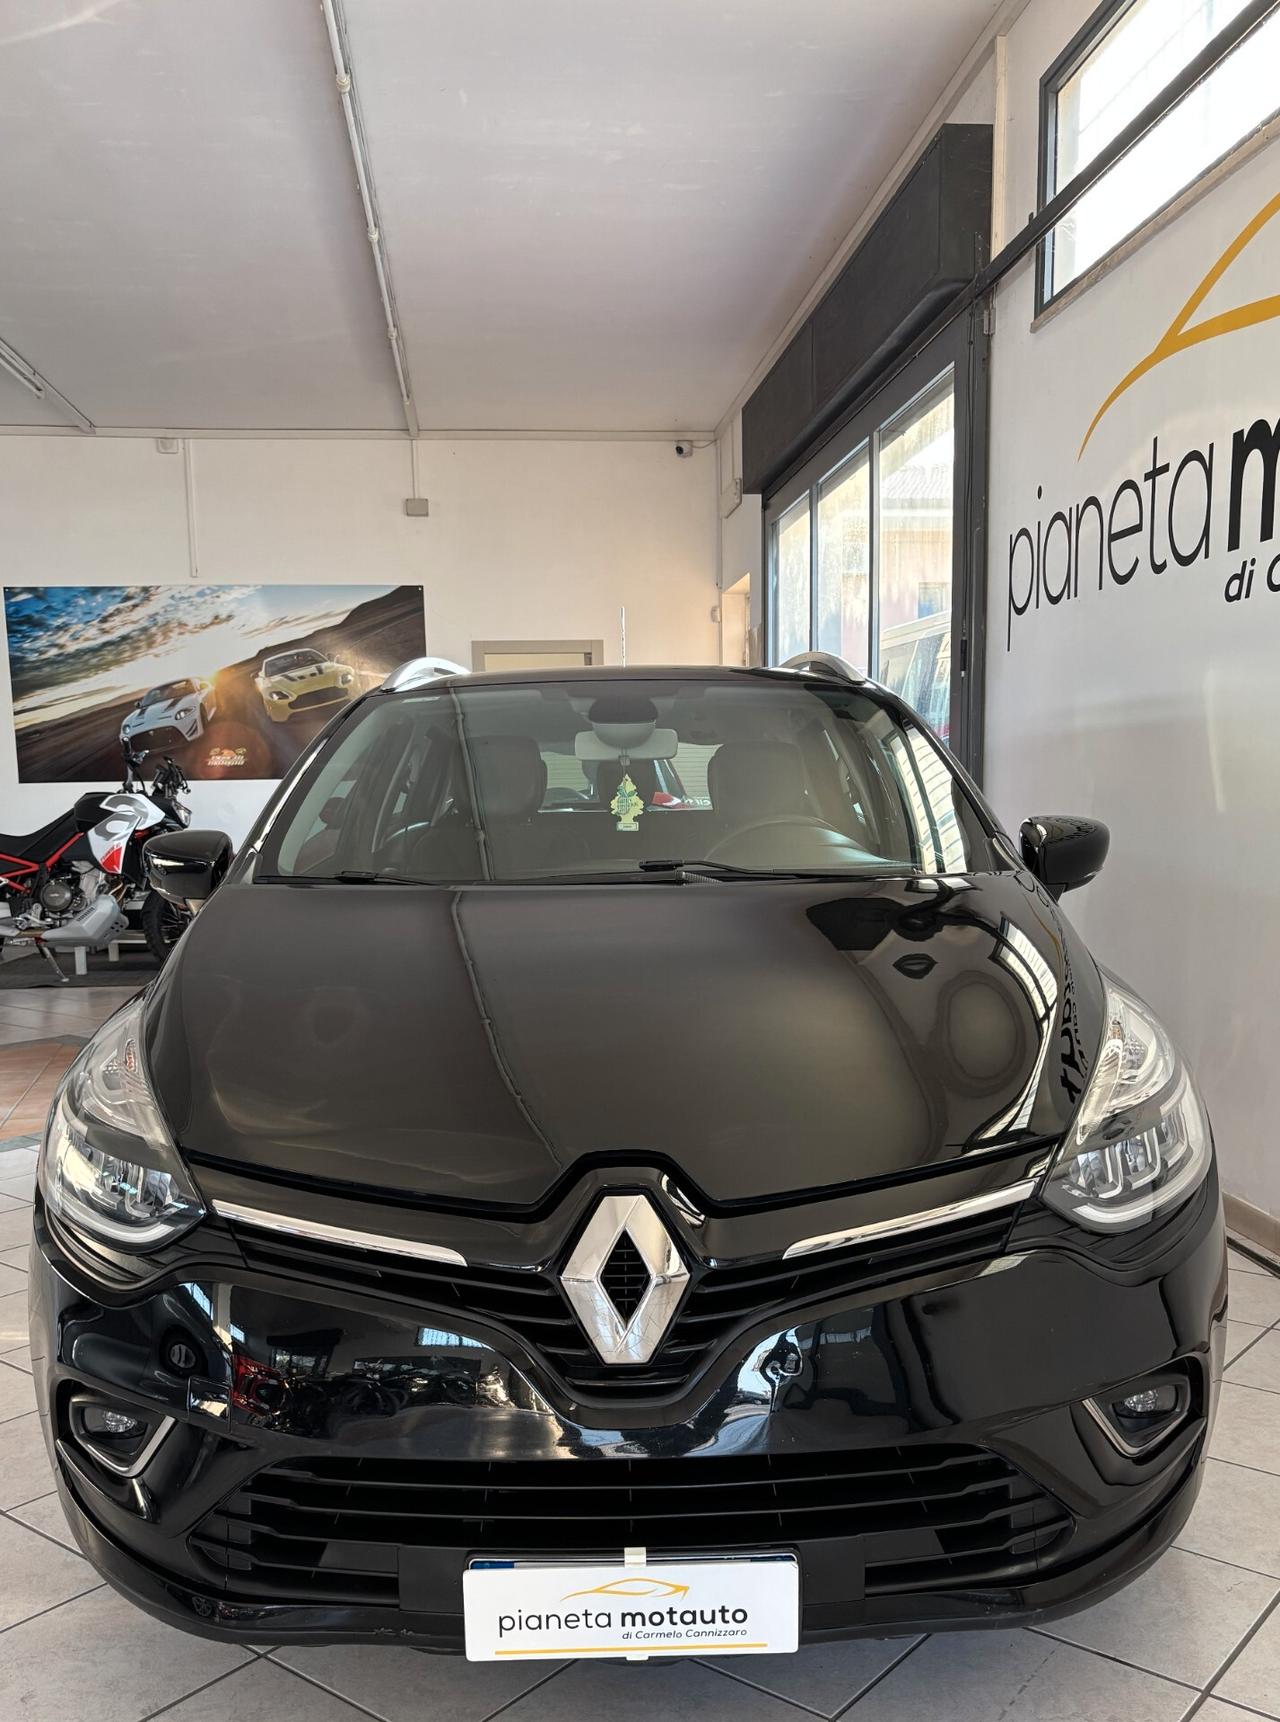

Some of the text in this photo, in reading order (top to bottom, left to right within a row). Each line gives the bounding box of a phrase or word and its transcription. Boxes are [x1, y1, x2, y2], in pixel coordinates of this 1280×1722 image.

[1007, 436, 1214, 652] pianeta
[1224, 557, 1256, 603] di
[499, 1605, 748, 1638] pianeta motauto
[622, 1628, 747, 1640] di Carmelo Cannizzaro
